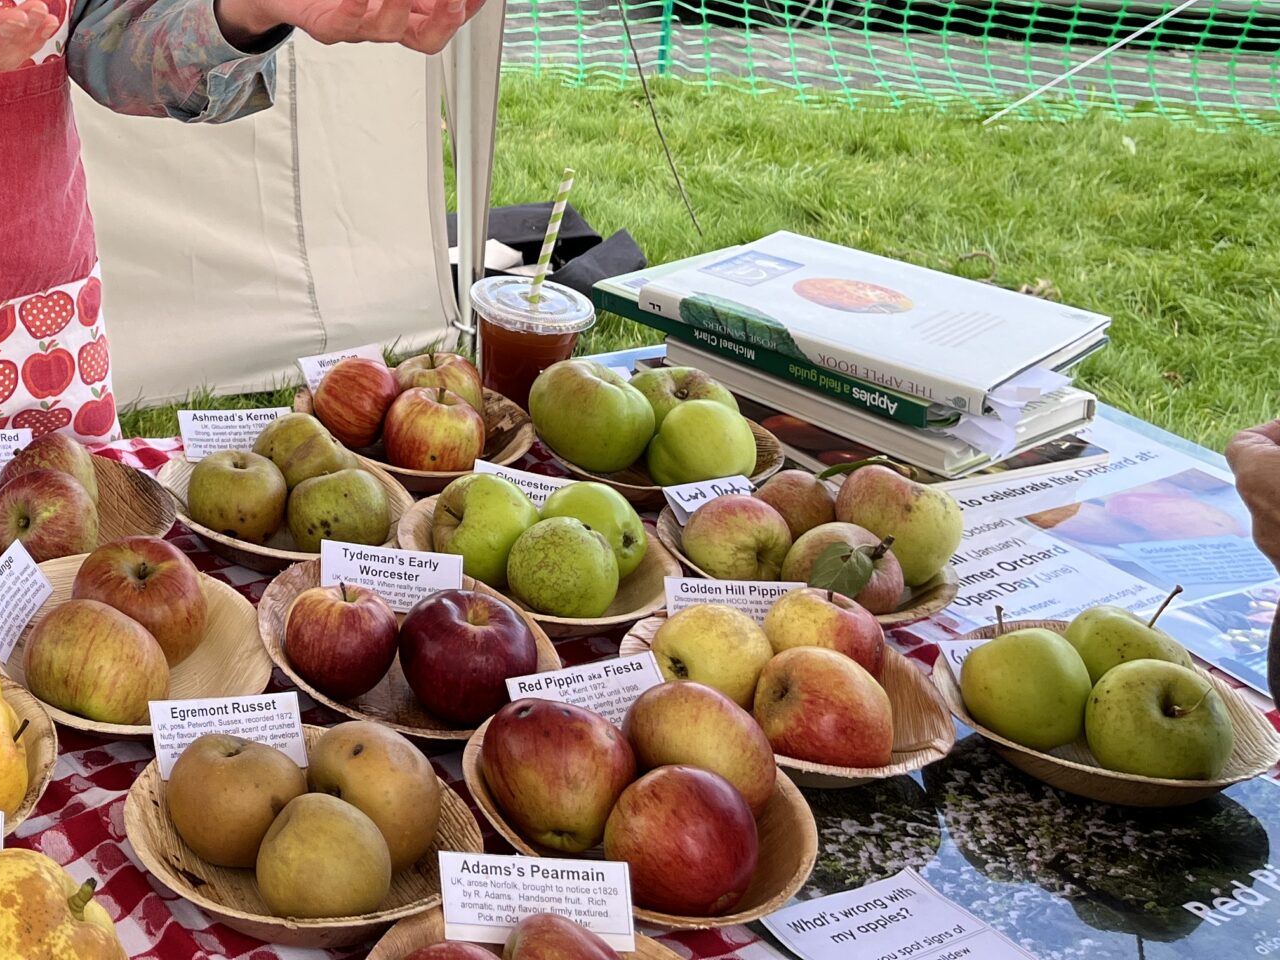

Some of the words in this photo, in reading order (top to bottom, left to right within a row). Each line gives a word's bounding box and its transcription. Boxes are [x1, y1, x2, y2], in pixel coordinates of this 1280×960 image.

[693, 329, 717, 347] Clark
[702, 319, 747, 342] SANDERS
[746, 333, 777, 349] ROSIE
[720, 341, 756, 360] Michael
[788, 364, 818, 383] guide
[817, 353, 858, 376] BOOK
[819, 375, 842, 392] field
[863, 367, 903, 392] APPLE
[844, 385, 850, 393] a
[906, 382, 935, 399] THE
[851, 386, 899, 415] Apples
[192, 413, 243, 422] Ashmead's
[246, 412, 278, 421] Kernel
[1, 433, 19, 442] Red
[496, 472, 564, 492] Gloucesters
[960, 498, 983, 508] to
[982, 480, 1051, 503] celebrate
[1053, 473, 1080, 486] the
[1079, 458, 1134, 479] Orchard
[1135, 450, 1159, 463] at:
[961, 517, 1015, 538] (October)
[965, 537, 1027, 560] (January)
[342, 548, 405, 566] Tydeman's
[409, 556, 439, 572] Early
[997, 544, 1070, 573] Orchard
[359, 565, 420, 582] Worcester
[344, 576, 358, 584] Kent
[396, 584, 414, 592] really
[414, 585, 427, 593] ripe
[680, 583, 721, 595] Golden
[725, 585, 745, 595] Hill
[749, 586, 788, 598] Pippin
[953, 586, 1004, 609] Open
[1004, 575, 1040, 593] Day
[1034, 564, 1079, 584] (June)
[675, 595, 707, 603] Discovered
[518, 680, 543, 693] Red
[545, 673, 585, 688] Pippin
[603, 661, 643, 677] Fiesta
[573, 686, 588, 694] Kent
[607, 689, 621, 697] until
[170, 704, 229, 721] Egremont
[232, 700, 277, 714] Russet
[594, 700, 614, 710] plenty
[245, 715, 274, 724] recorded
[268, 722, 295, 731] crushed
[270, 732, 299, 741] develops
[460, 860, 525, 877] Adams's
[530, 864, 605, 882] Pearmain
[467, 880, 488, 888] arose
[522, 883, 553, 893] brought
[555, 885, 563, 893] to
[566, 886, 591, 895] notice
[462, 890, 472, 898] by
[518, 894, 562, 904] Handsome
[588, 897, 607, 906] Rich
[1182, 880, 1271, 926] Red
[478, 913, 494, 922] Pick
[497, 903, 516, 914] nutty
[550, 907, 572, 917] firmly
[786, 911, 841, 934] What's
[840, 897, 889, 920] wrong
[886, 886, 916, 904] with
[830, 928, 857, 945] my
[860, 906, 914, 935] apples?
[898, 941, 922, 957] spot
[925, 931, 953, 948] signs
[953, 925, 966, 935] of
